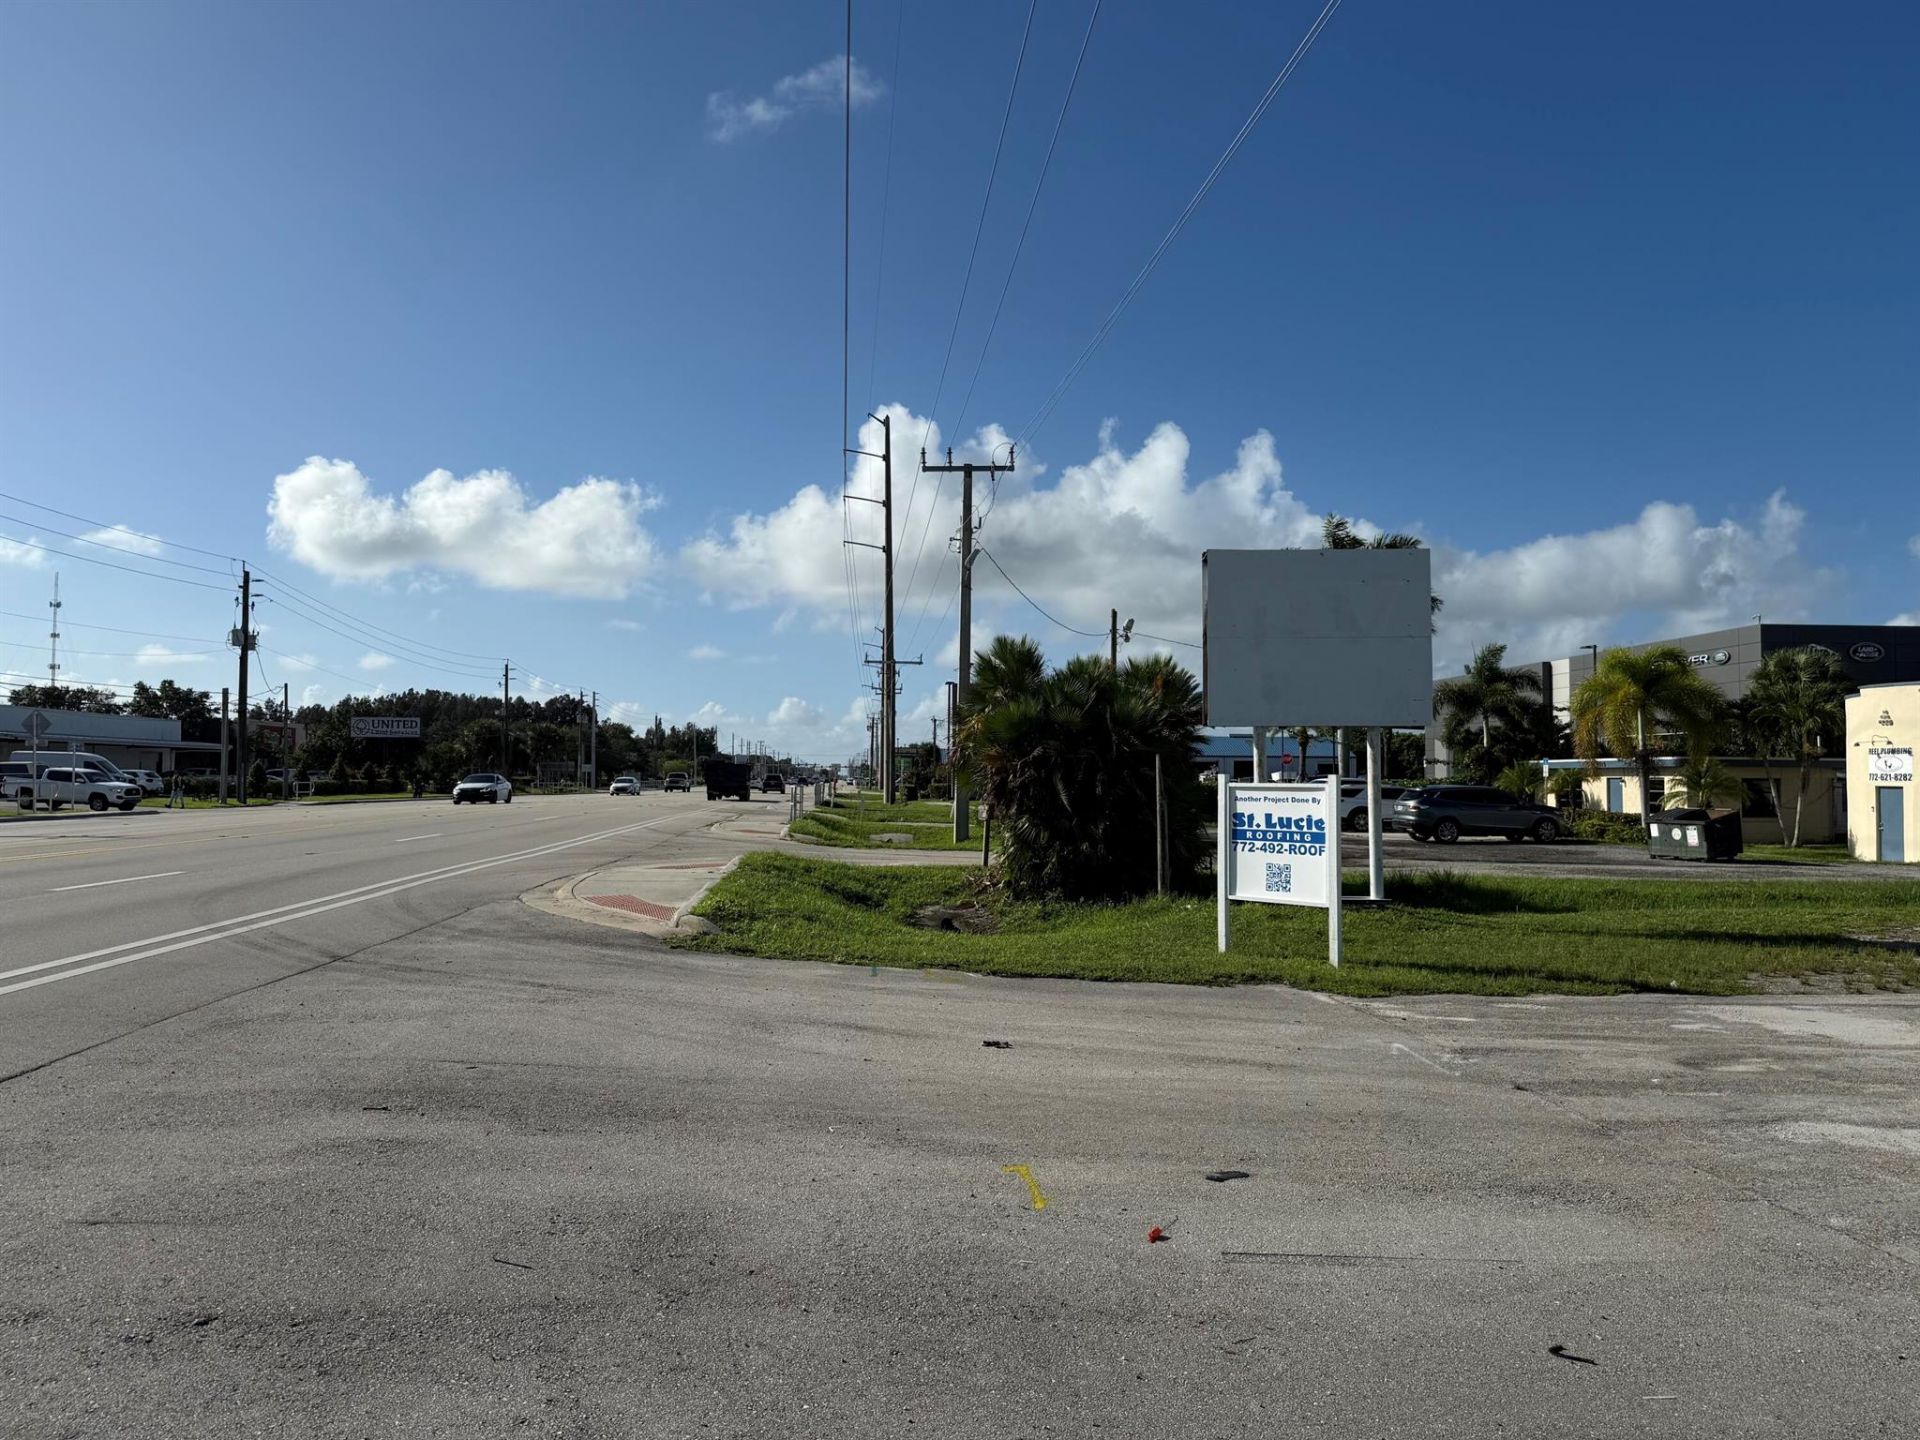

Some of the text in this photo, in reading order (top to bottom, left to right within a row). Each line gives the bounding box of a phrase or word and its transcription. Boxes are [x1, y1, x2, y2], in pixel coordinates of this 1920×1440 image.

[372, 719, 418, 729] UNITED
[1880, 747, 1912, 755] PLUMBING
[1868, 773, 1913, 781] 772-621-8282
[1234, 795, 1262, 803] Another
[1263, 796, 1289, 804] Project
[1311, 797, 1321, 805] By
[1232, 811, 1326, 831] St. Lucie
[1246, 831, 1312, 841] ROOFING
[1231, 841, 1326, 856] 772-492-ROOF
